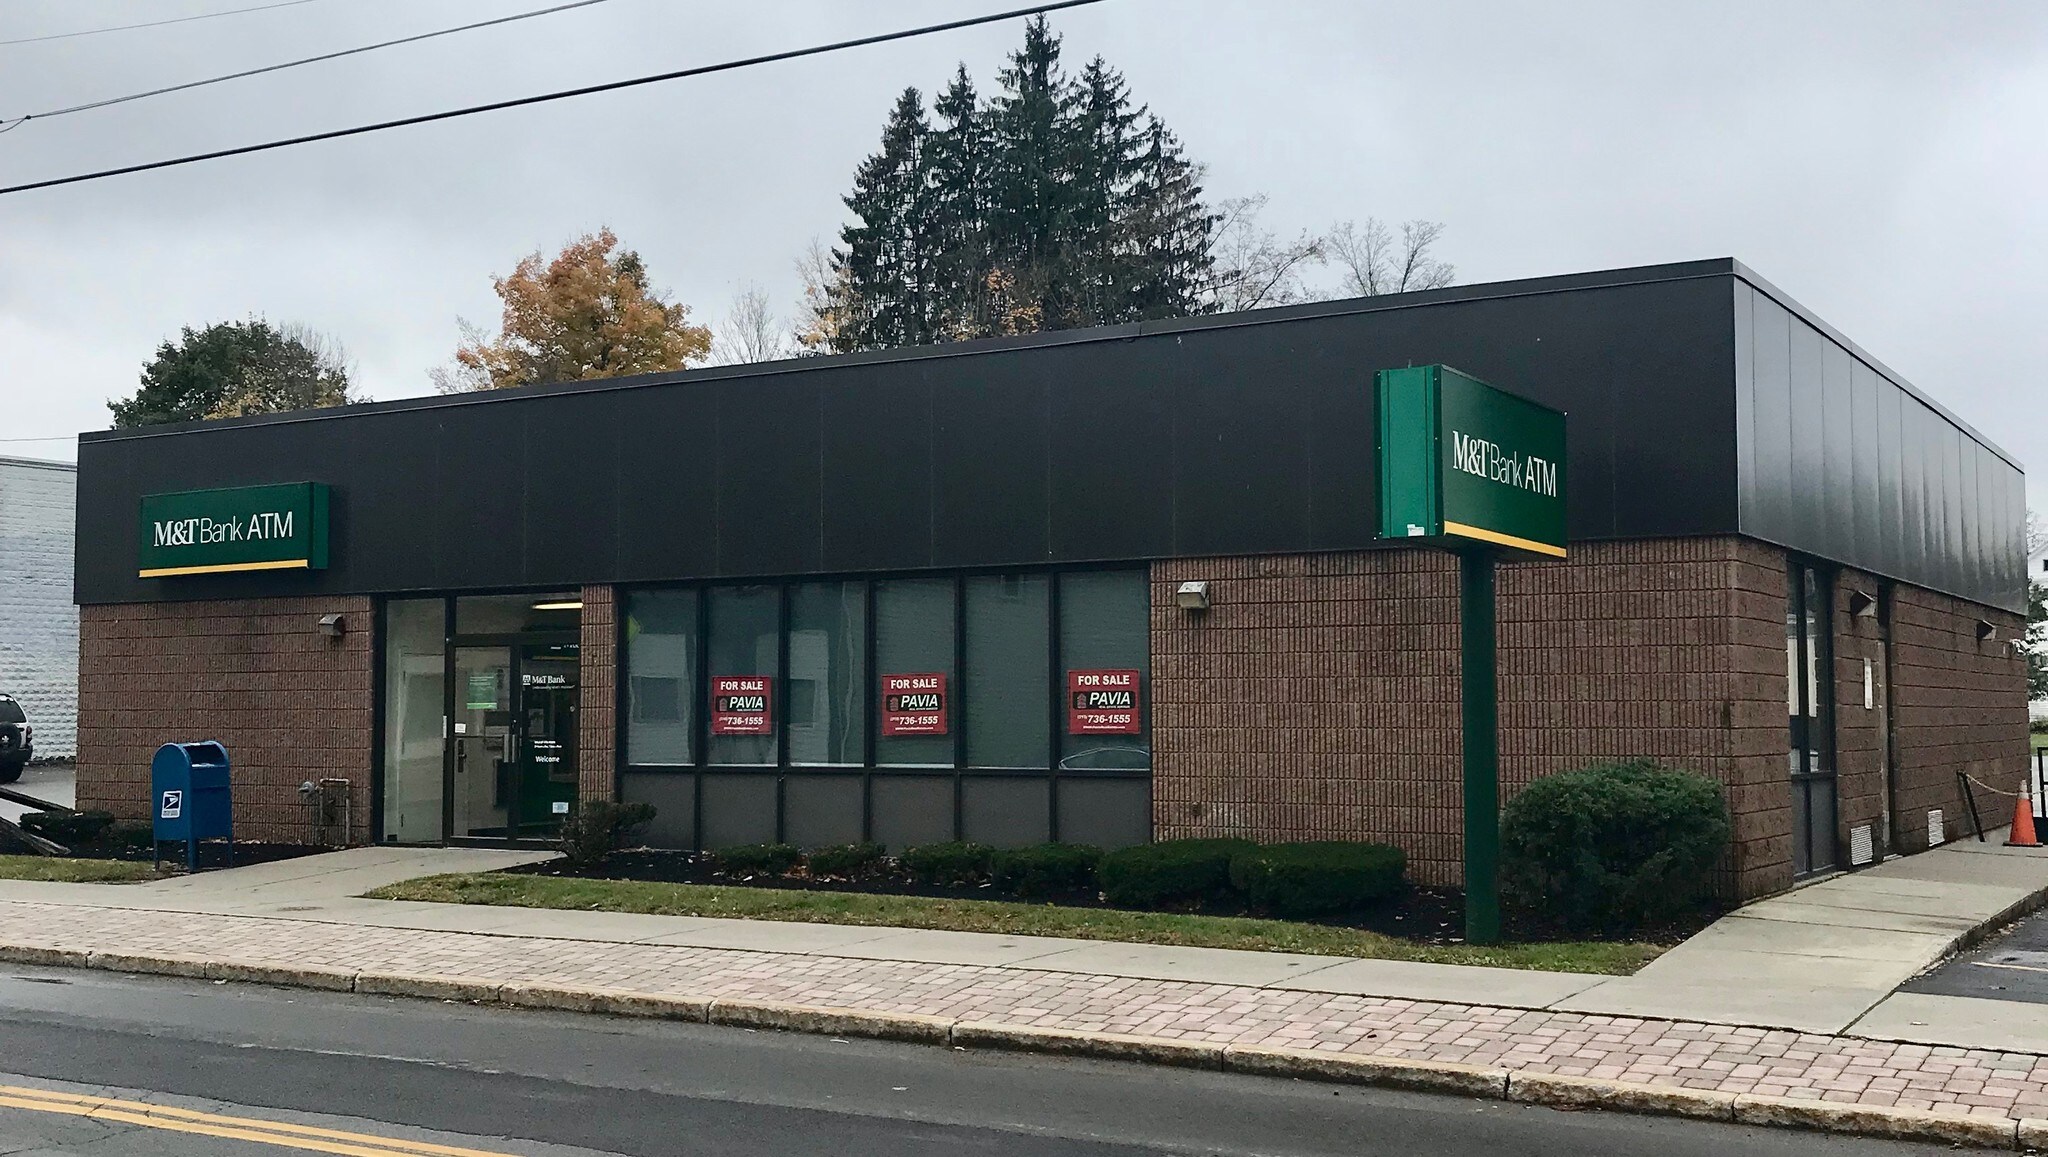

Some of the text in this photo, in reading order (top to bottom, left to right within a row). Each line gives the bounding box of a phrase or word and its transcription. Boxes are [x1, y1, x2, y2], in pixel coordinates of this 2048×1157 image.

[1452, 430, 1557, 497] M&T Bank ATM
[153, 511, 293, 547] M&T Bank ATM
[548, 674, 566, 684] Bank
[890, 678, 938, 689] FOR SALE
[1078, 675, 1130, 686] FOR SALE
[720, 681, 764, 690] FOR SALE
[729, 696, 763, 708] PAVIA
[900, 694, 938, 708] PAVIA
[1089, 692, 1131, 705] PAVIA
